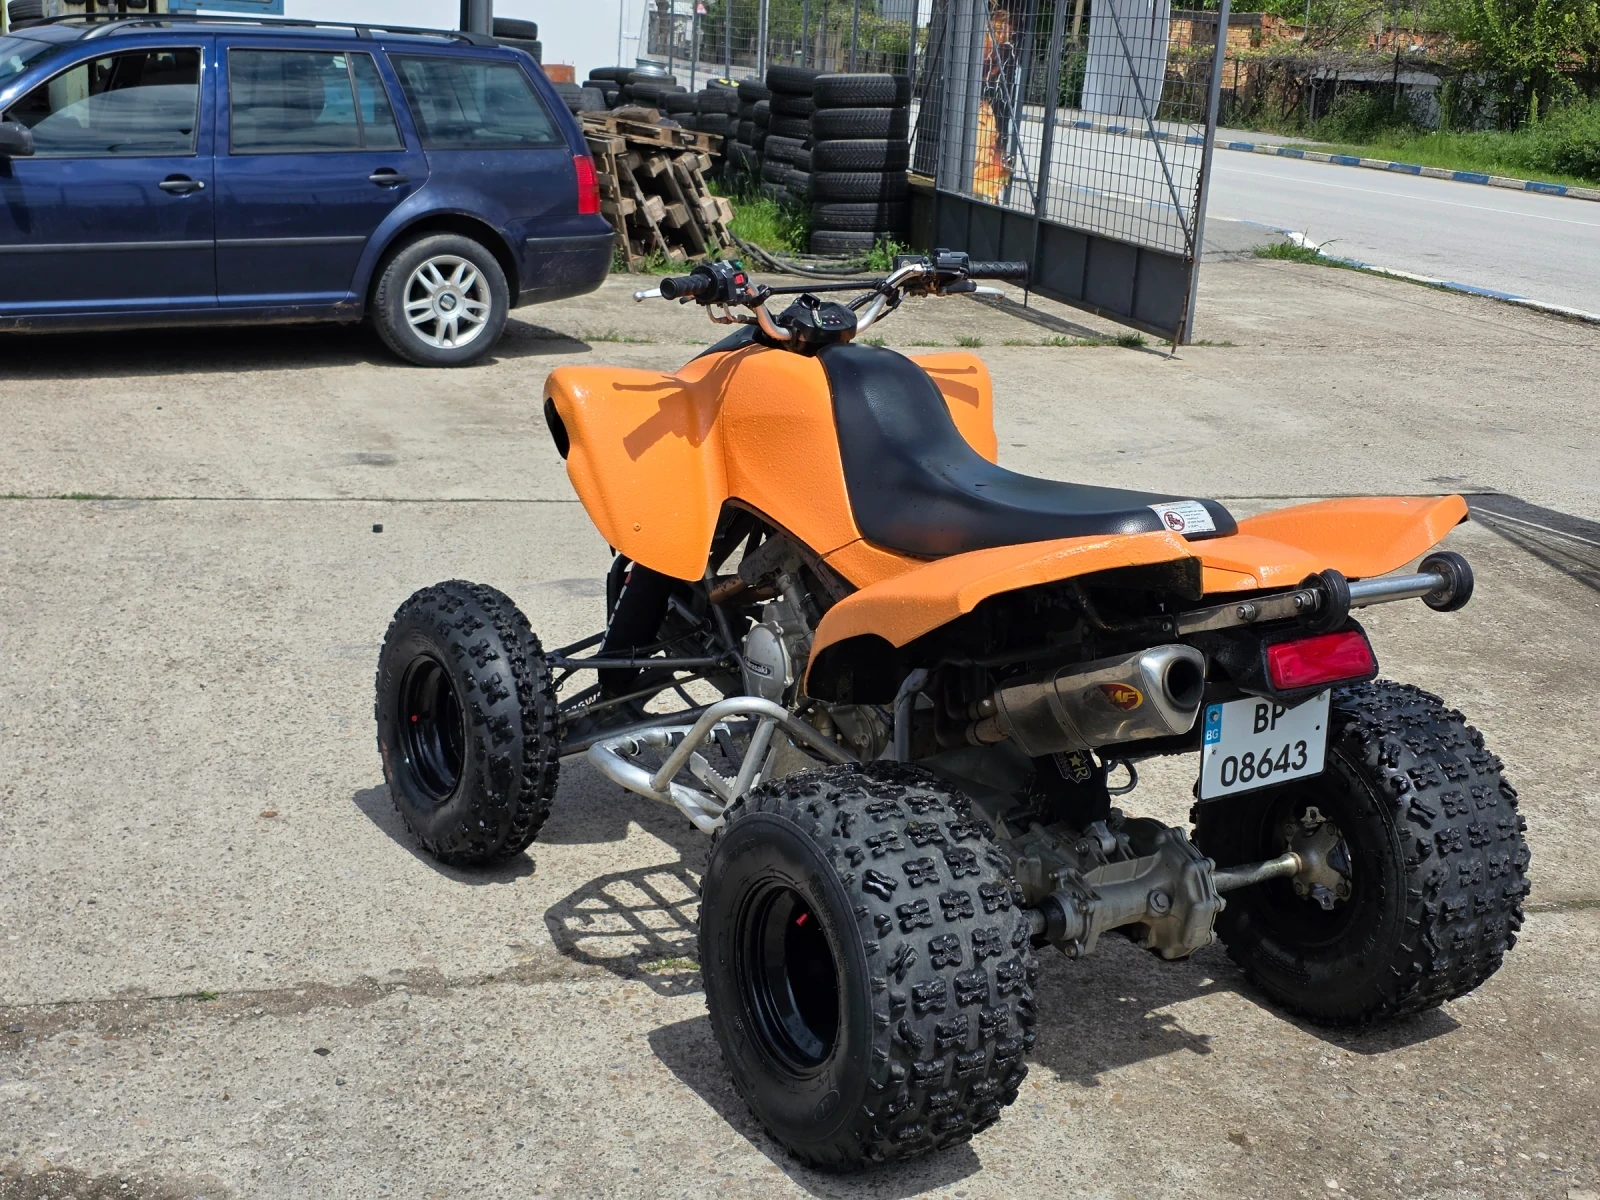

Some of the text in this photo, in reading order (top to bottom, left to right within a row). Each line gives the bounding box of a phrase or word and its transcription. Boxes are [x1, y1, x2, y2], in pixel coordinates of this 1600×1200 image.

[1253, 703, 1286, 734] BP
[1206, 728, 1219, 741] BG
[1220, 740, 1308, 787] 08643
